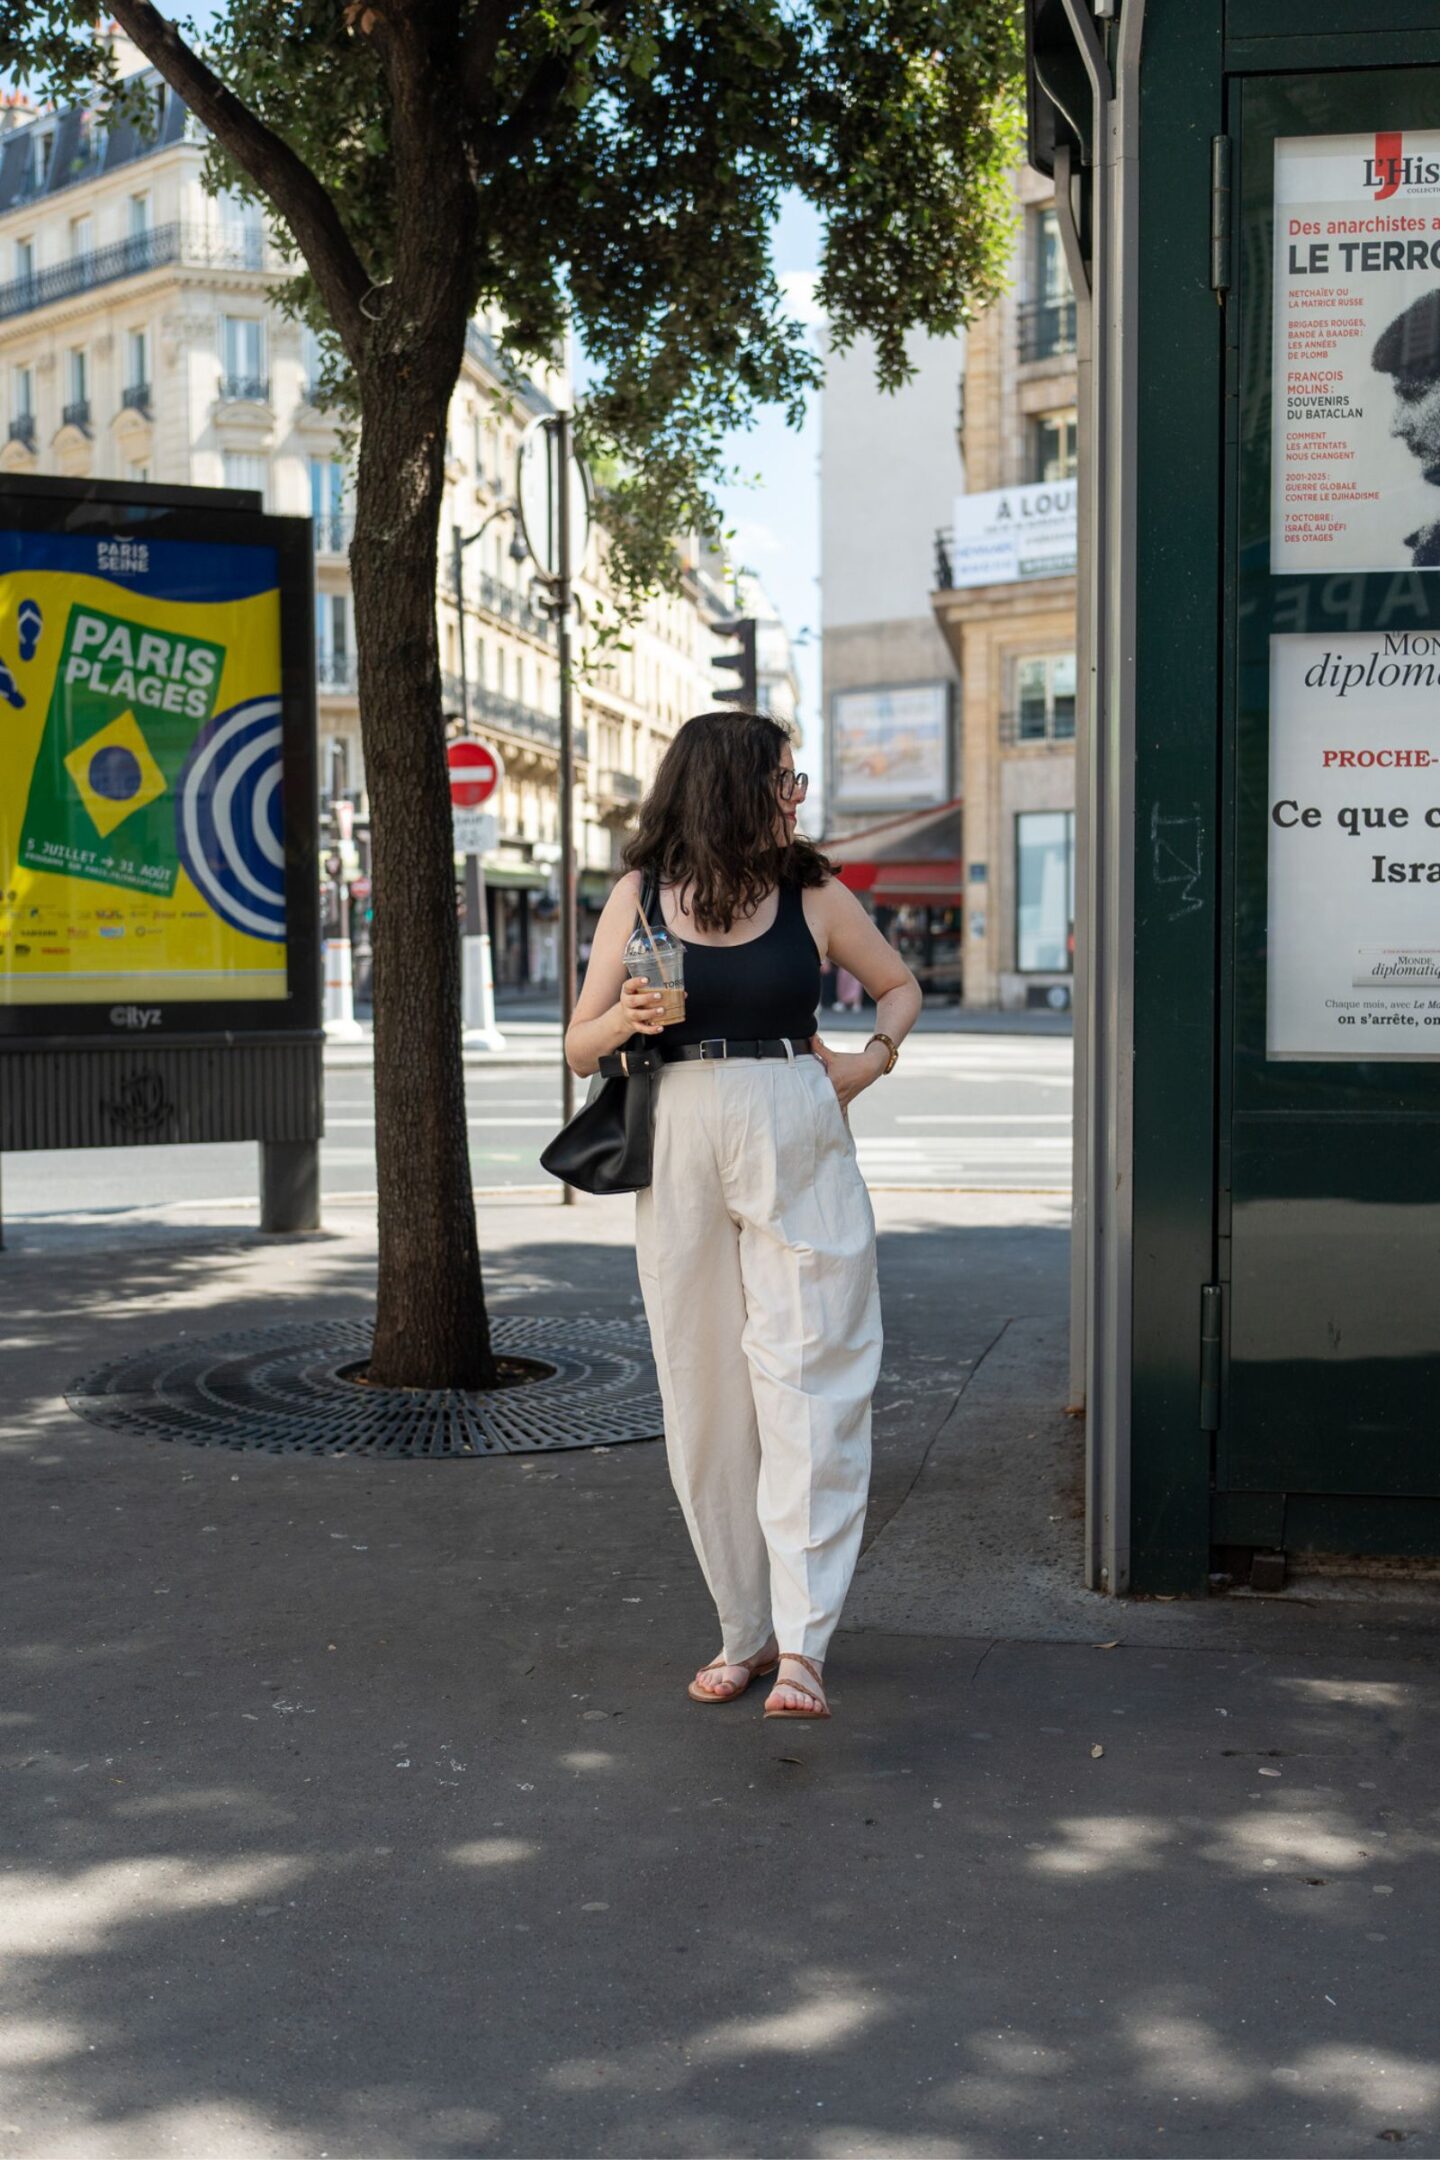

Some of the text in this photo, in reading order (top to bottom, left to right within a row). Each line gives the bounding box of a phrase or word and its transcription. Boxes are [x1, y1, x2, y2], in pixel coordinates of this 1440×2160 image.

[1289, 220, 1321, 236] Des
[1327, 215, 1426, 235] anarchistes
[1289, 244, 1329, 275] LE
[1288, 287, 1349, 298] NETCHAÏEV OU
[1289, 298, 1364, 309] LA MATRICE RUSSE
[1288, 318, 1366, 329] BRIGADES ROUGES,
[1288, 331, 1316, 339] BANDE
[1318, 329, 1324, 338] À
[1288, 339, 1337, 350] LES ANNÉES
[1288, 351, 1328, 360] DE PLOMB
[1287, 370, 1344, 382] FRANÇOIS
[1287, 395, 1350, 407] SOUVENIRS
[1287, 408, 1363, 420] DU BATACLAN
[1286, 431, 1327, 440] COMMENT
[1286, 441, 1347, 451] LES ATTENTATS
[1286, 452, 1355, 461] NOUS CHANGENT
[1285, 482, 1357, 491] GUERRE GLOBALE
[1285, 491, 1380, 502] CONTRE LE DJIHADISME
[1020, 490, 1077, 518] LOU
[1285, 514, 1290, 522] 7
[1315, 524, 1326, 532] AU
[1328, 521, 1347, 531] DÉFI
[1284, 534, 1333, 543] DES OTAGES
[97, 541, 149, 560] PARIS
[97, 556, 149, 573] SEINE
[70, 614, 217, 687] PARIS
[1304, 651, 1440, 698] diplom
[64, 656, 209, 718] PLAGES
[1322, 750, 1438, 768] PROCHE-
[1271, 799, 1322, 828] Ce
[1337, 806, 1409, 836] que
[27, 838, 35, 850] 5
[43, 842, 96, 862] JUILLET
[120, 860, 134, 873] 31
[1371, 855, 1440, 883] Isra
[1325, 999, 1360, 1010] Chaque
[1363, 1000, 1388, 1010] mois,
[1414, 1000, 1425, 1009] Le
[1338, 1015, 1356, 1025] on
